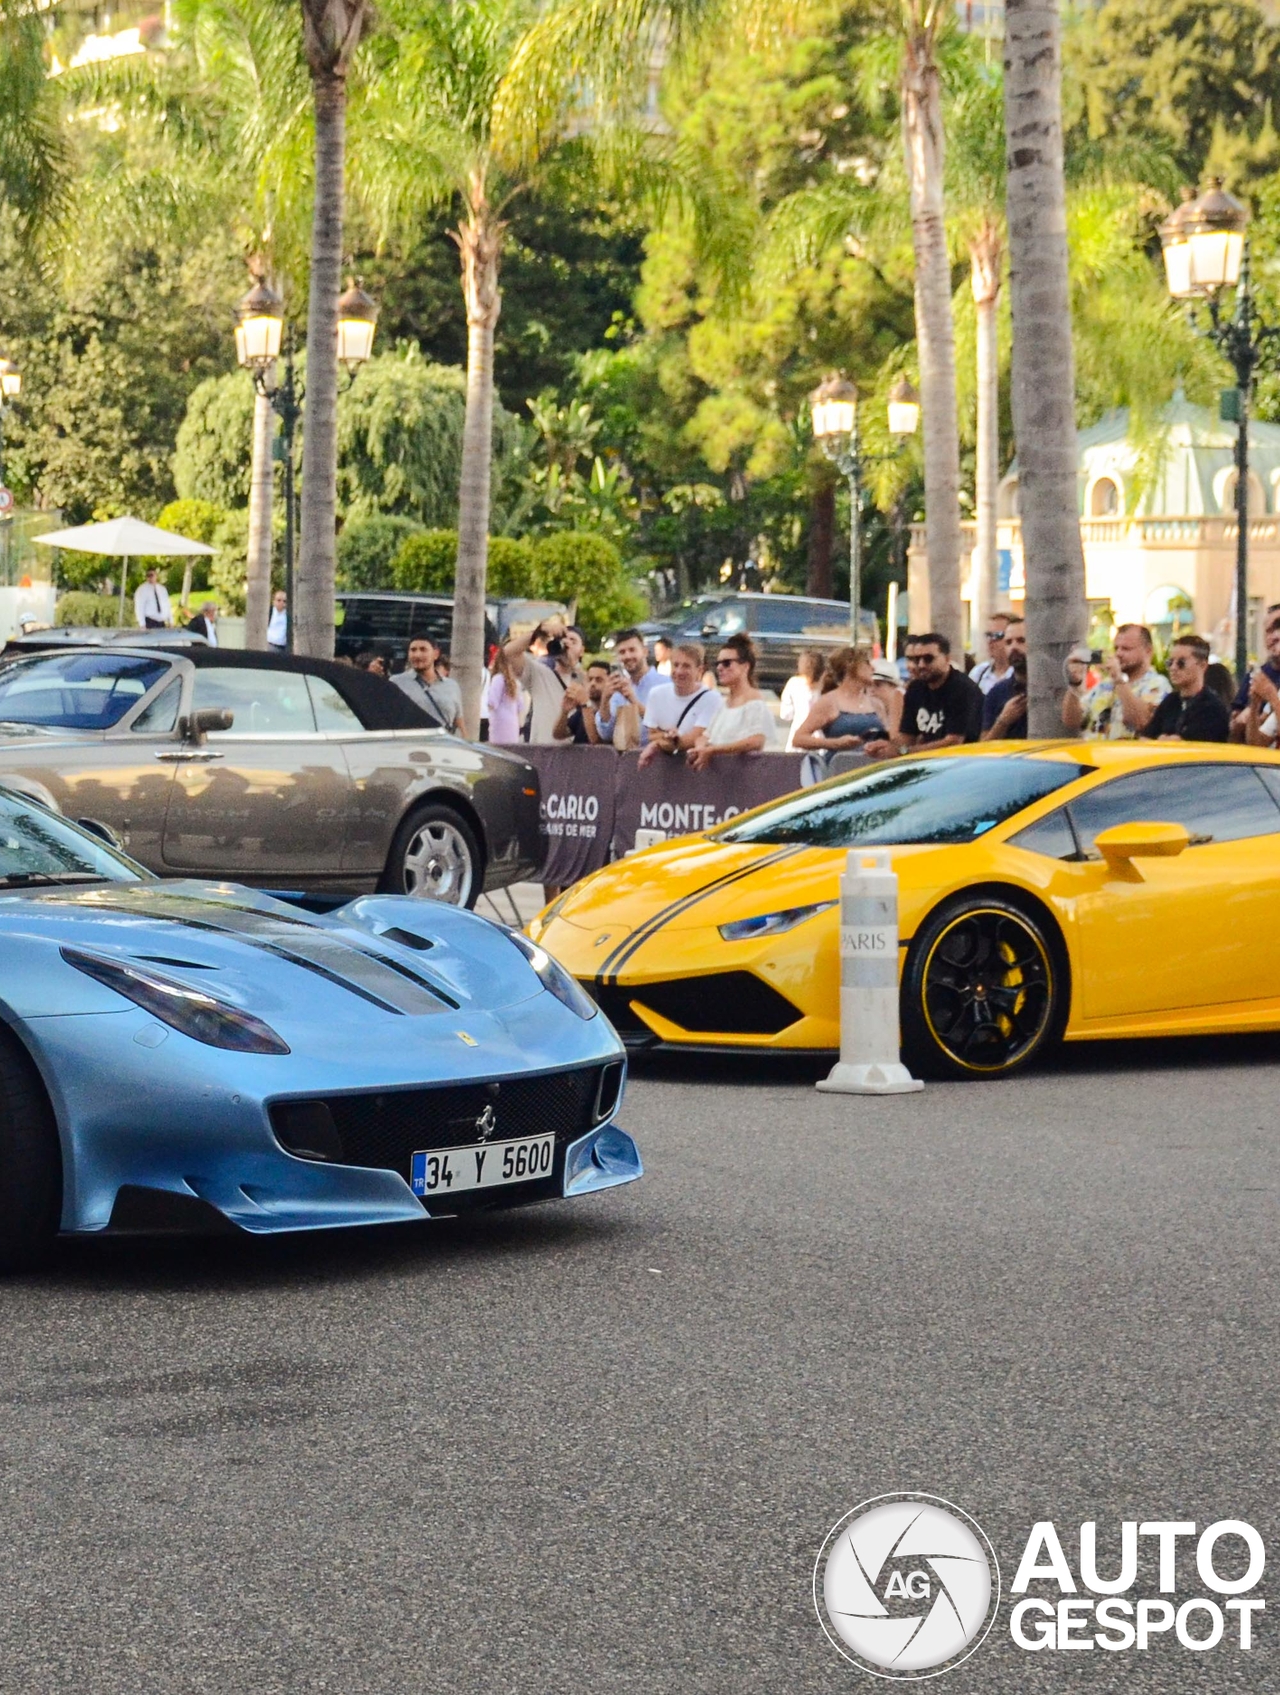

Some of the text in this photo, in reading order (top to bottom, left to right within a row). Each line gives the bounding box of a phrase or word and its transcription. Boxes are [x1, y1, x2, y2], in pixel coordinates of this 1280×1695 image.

[565, 823, 578, 837] DE
[426, 1140, 551, 1190] 34 Y 5600
[414, 1177, 425, 1188] TR
